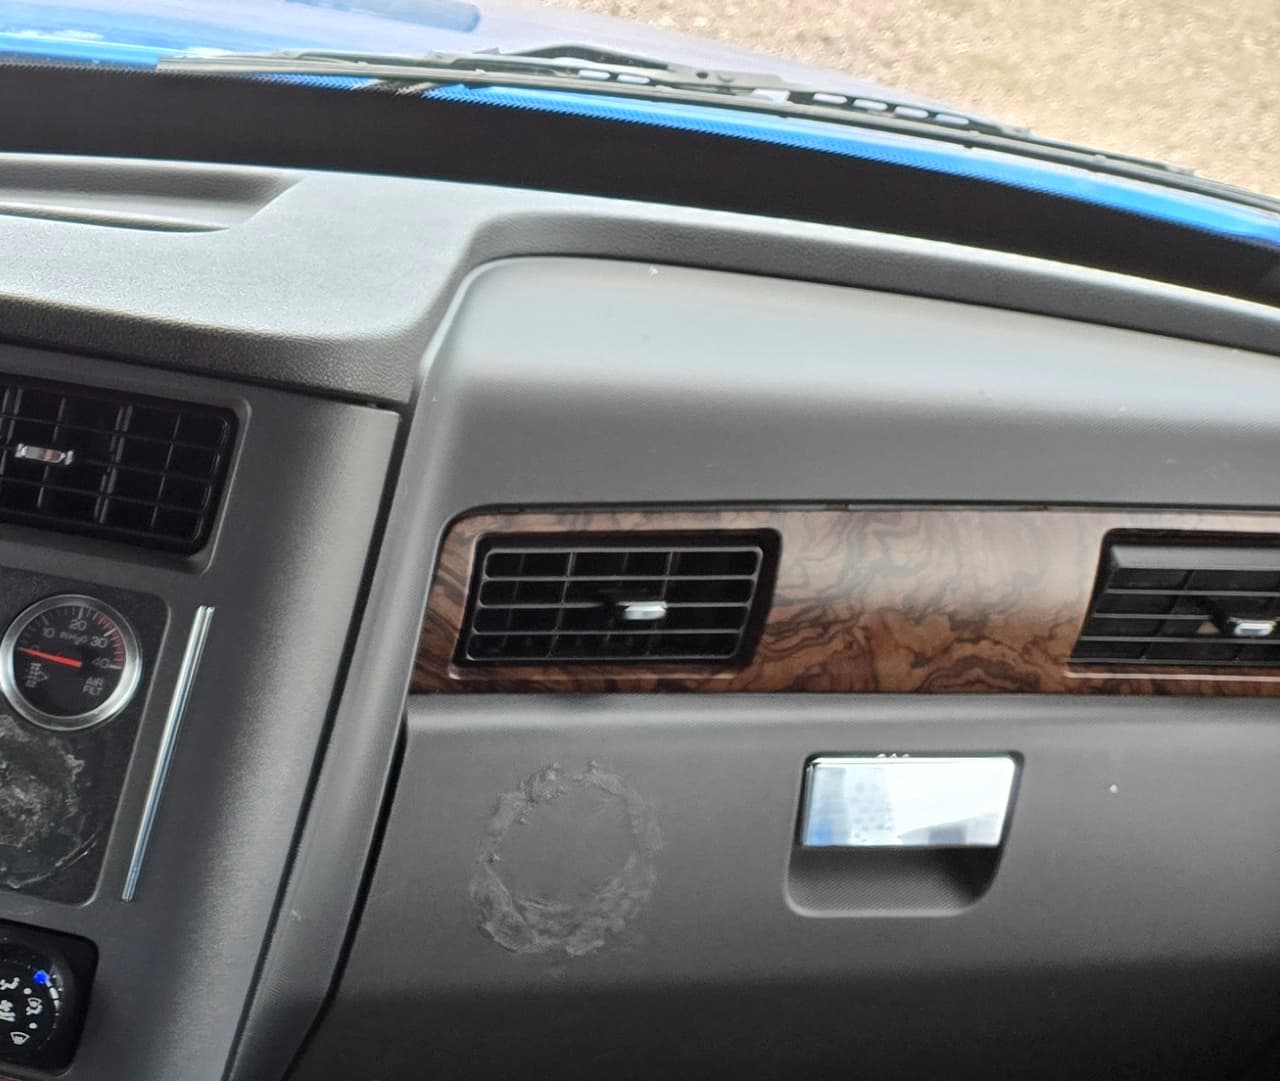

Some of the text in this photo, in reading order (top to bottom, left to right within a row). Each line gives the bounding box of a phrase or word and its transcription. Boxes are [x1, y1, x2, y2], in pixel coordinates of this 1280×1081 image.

[69, 618, 88, 631] 20
[42, 627, 56, 638] 10
[90, 636, 108, 648] 30
[92, 658, 110, 669] 40
[85, 676, 104, 686] AIR
